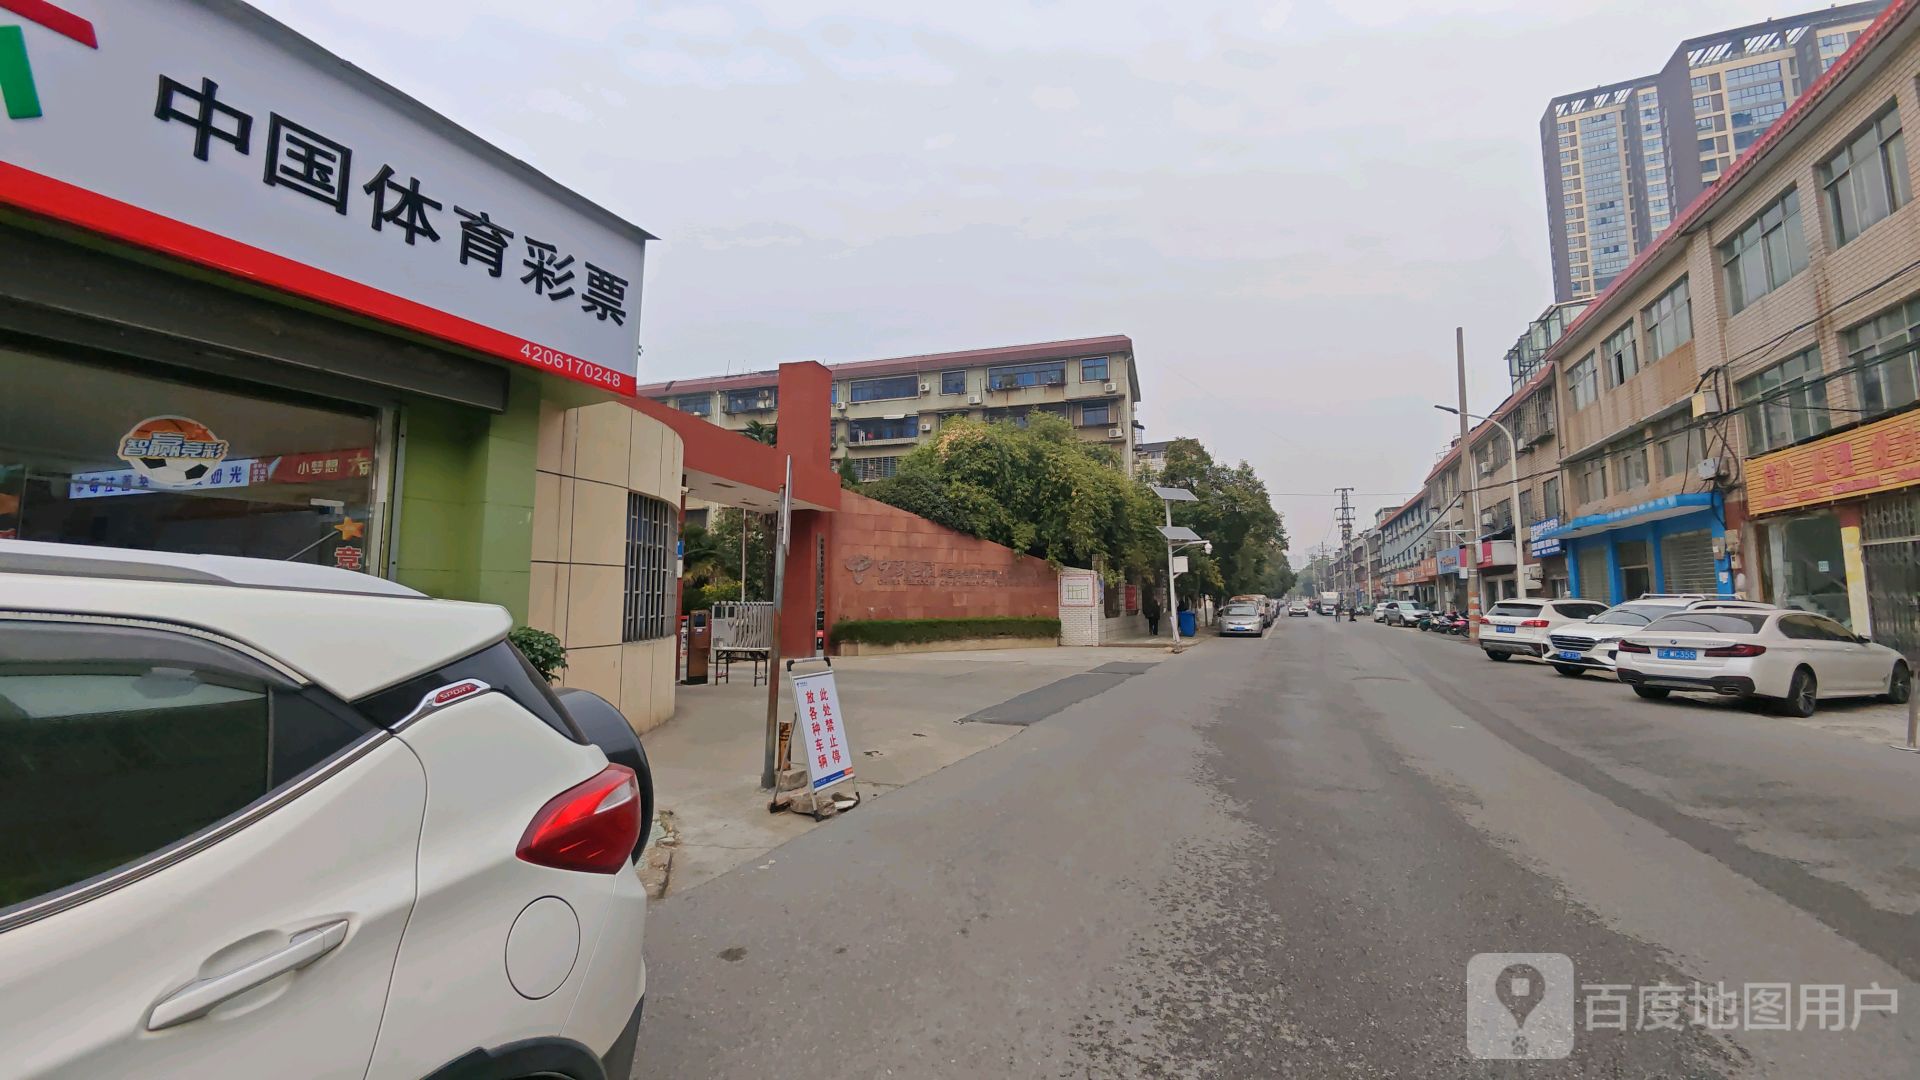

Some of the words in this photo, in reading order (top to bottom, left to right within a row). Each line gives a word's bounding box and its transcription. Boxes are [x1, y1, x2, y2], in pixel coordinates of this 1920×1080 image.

[154, 73, 629, 327] 中国体育彩票
[520, 343, 621, 387] 4206170248
[123, 432, 225, 459] 智赢竞彩
[439, 683, 472, 699] SPORT
[805, 690, 829, 769] 放各种车辆
[819, 687, 842, 764] 此处禁止停
